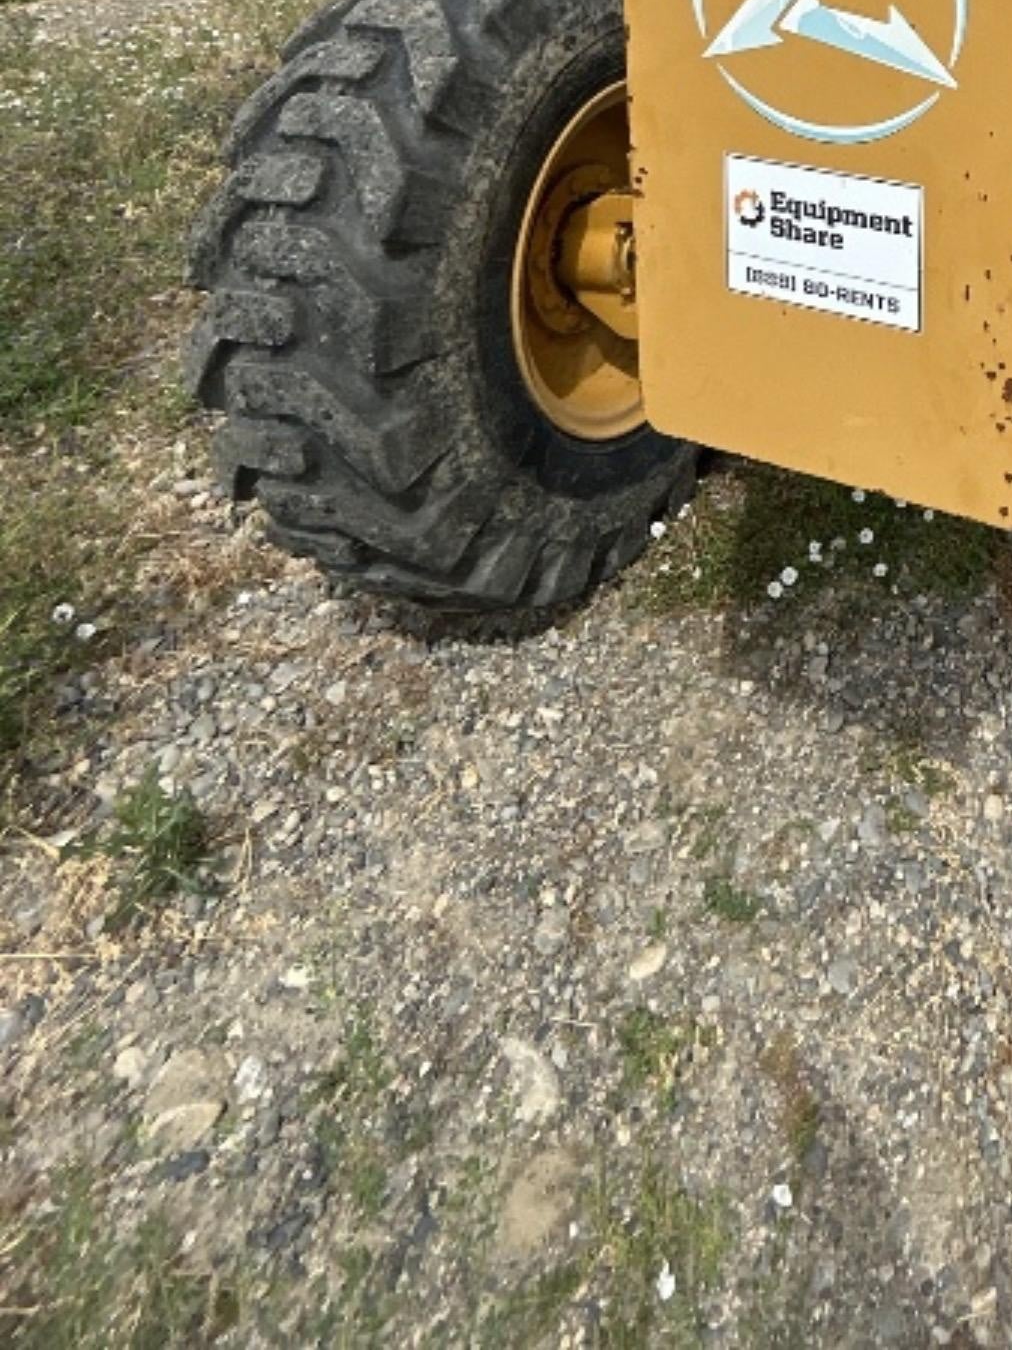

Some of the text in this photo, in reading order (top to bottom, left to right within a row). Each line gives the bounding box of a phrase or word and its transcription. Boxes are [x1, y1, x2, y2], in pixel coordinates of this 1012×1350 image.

[769, 190, 914, 238] Equipment
[769, 215, 845, 250] Share
[802, 278, 901, 314] 80-RENTS
